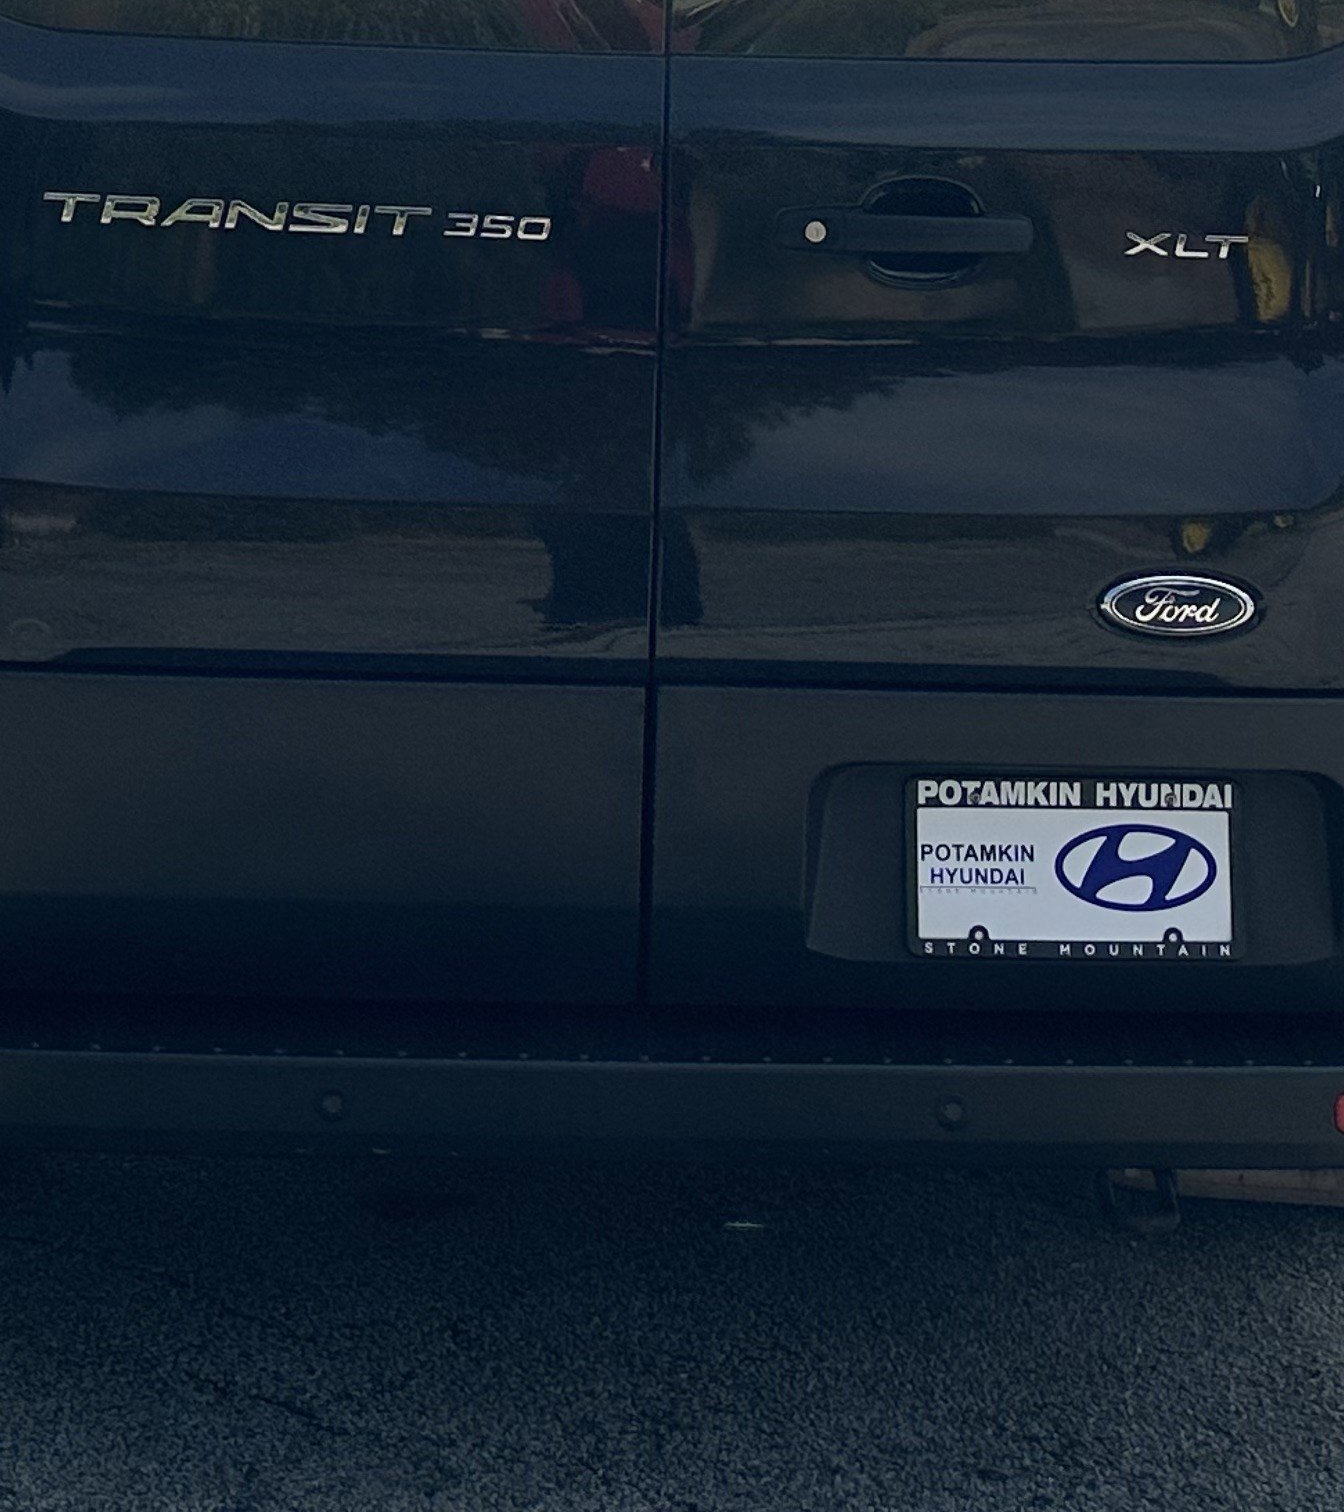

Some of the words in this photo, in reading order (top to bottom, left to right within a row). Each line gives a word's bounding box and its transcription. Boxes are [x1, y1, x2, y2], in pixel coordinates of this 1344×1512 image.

[43, 191, 432, 237] TRANSIT
[443, 213, 552, 241] 350
[1123, 231, 1249, 259] XLT
[1135, 587, 1221, 623] Ford
[917, 780, 1082, 806] POTAMKIN
[1096, 783, 1233, 808] HYUNDAI
[920, 844, 1035, 862] POTAMKIN
[930, 867, 1025, 886] HYUNDAI
[923, 942, 1028, 956] STONE
[1059, 943, 1232, 957] MOUNTAIN
